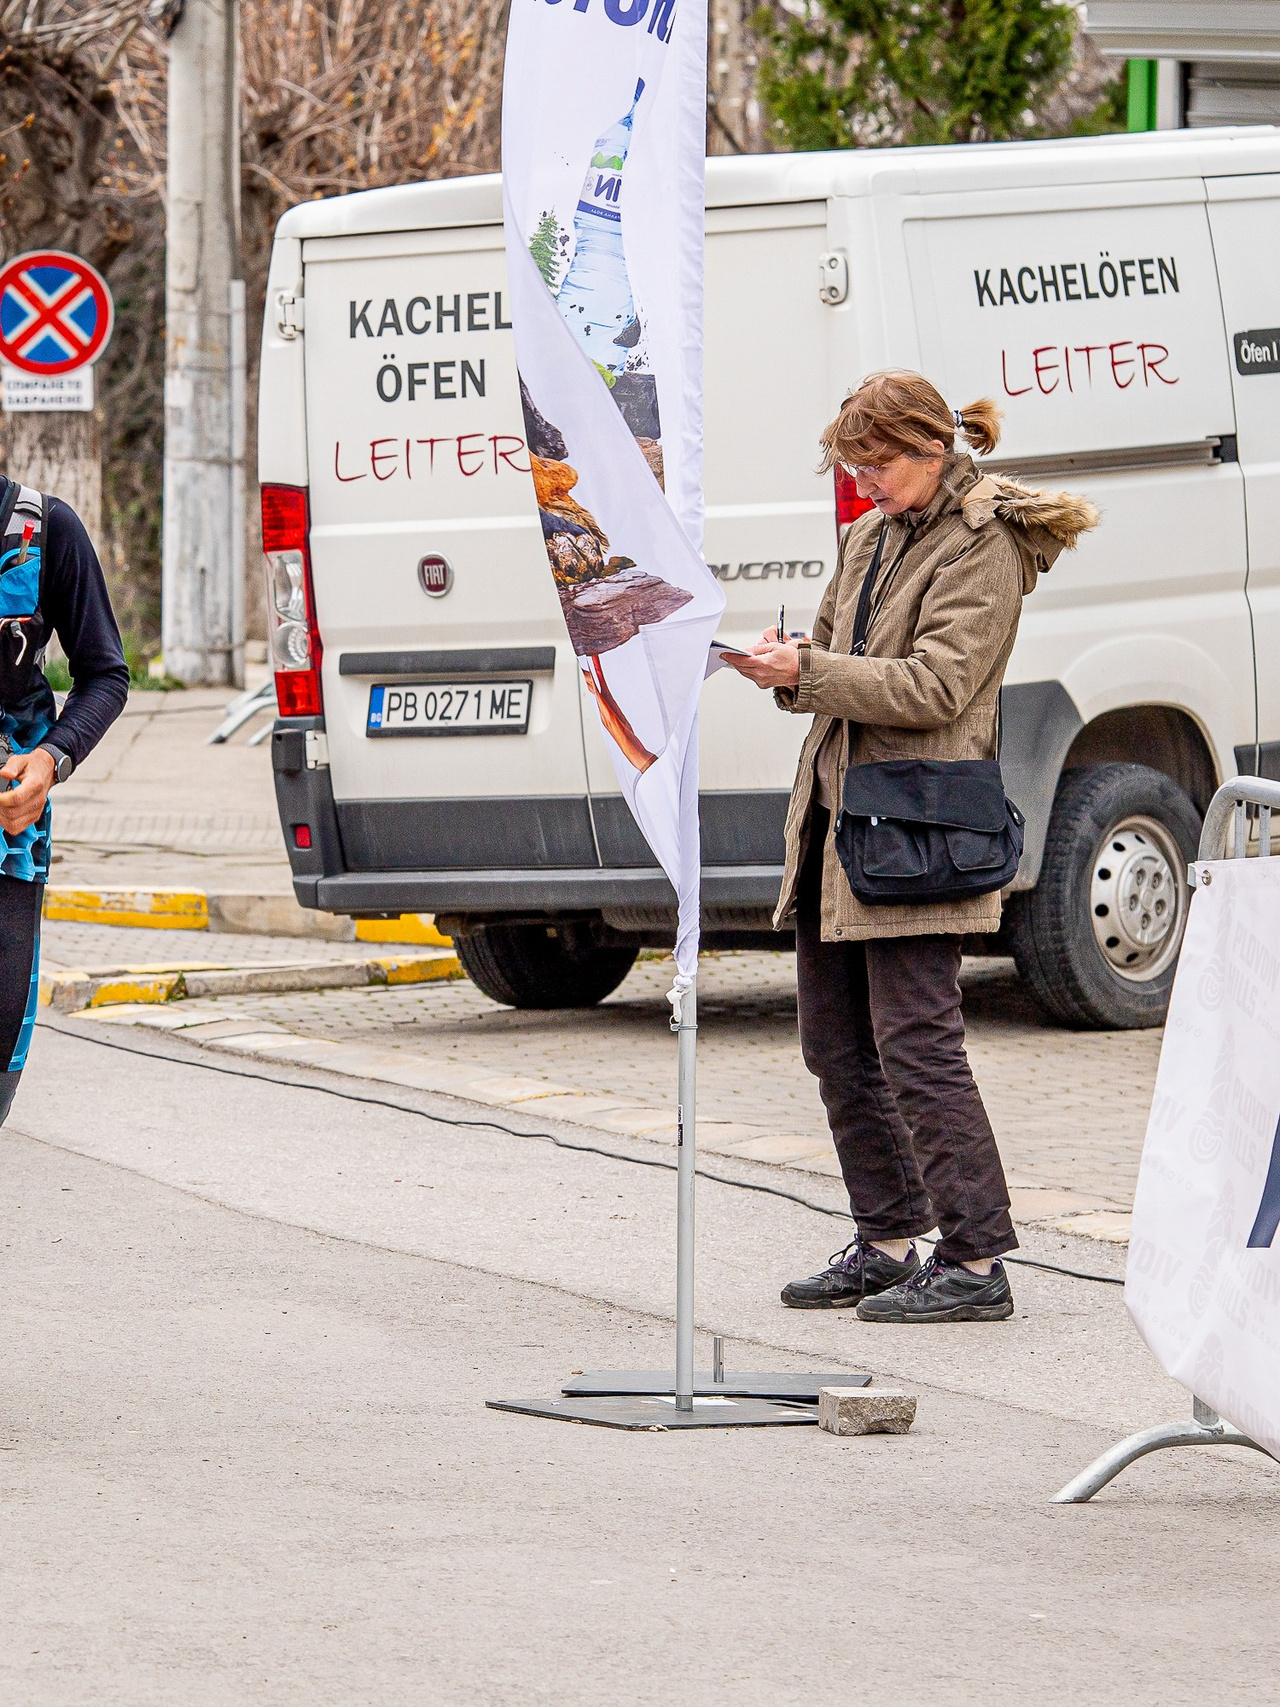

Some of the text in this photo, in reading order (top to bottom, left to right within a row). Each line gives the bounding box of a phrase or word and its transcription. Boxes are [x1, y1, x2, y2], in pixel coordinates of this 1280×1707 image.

[973, 251, 1181, 308] KACHELÖFEN
[348, 291, 513, 340] KACHEL
[1001, 341, 1180, 396] LEITER
[1240, 339, 1271, 363] Öfen
[376, 353, 487, 402] ÖFEN
[333, 433, 533, 482] LEITER
[423, 564, 445, 586] FIAT
[370, 712, 382, 723] BG
[386, 689, 523, 722] PB 0271 ME
